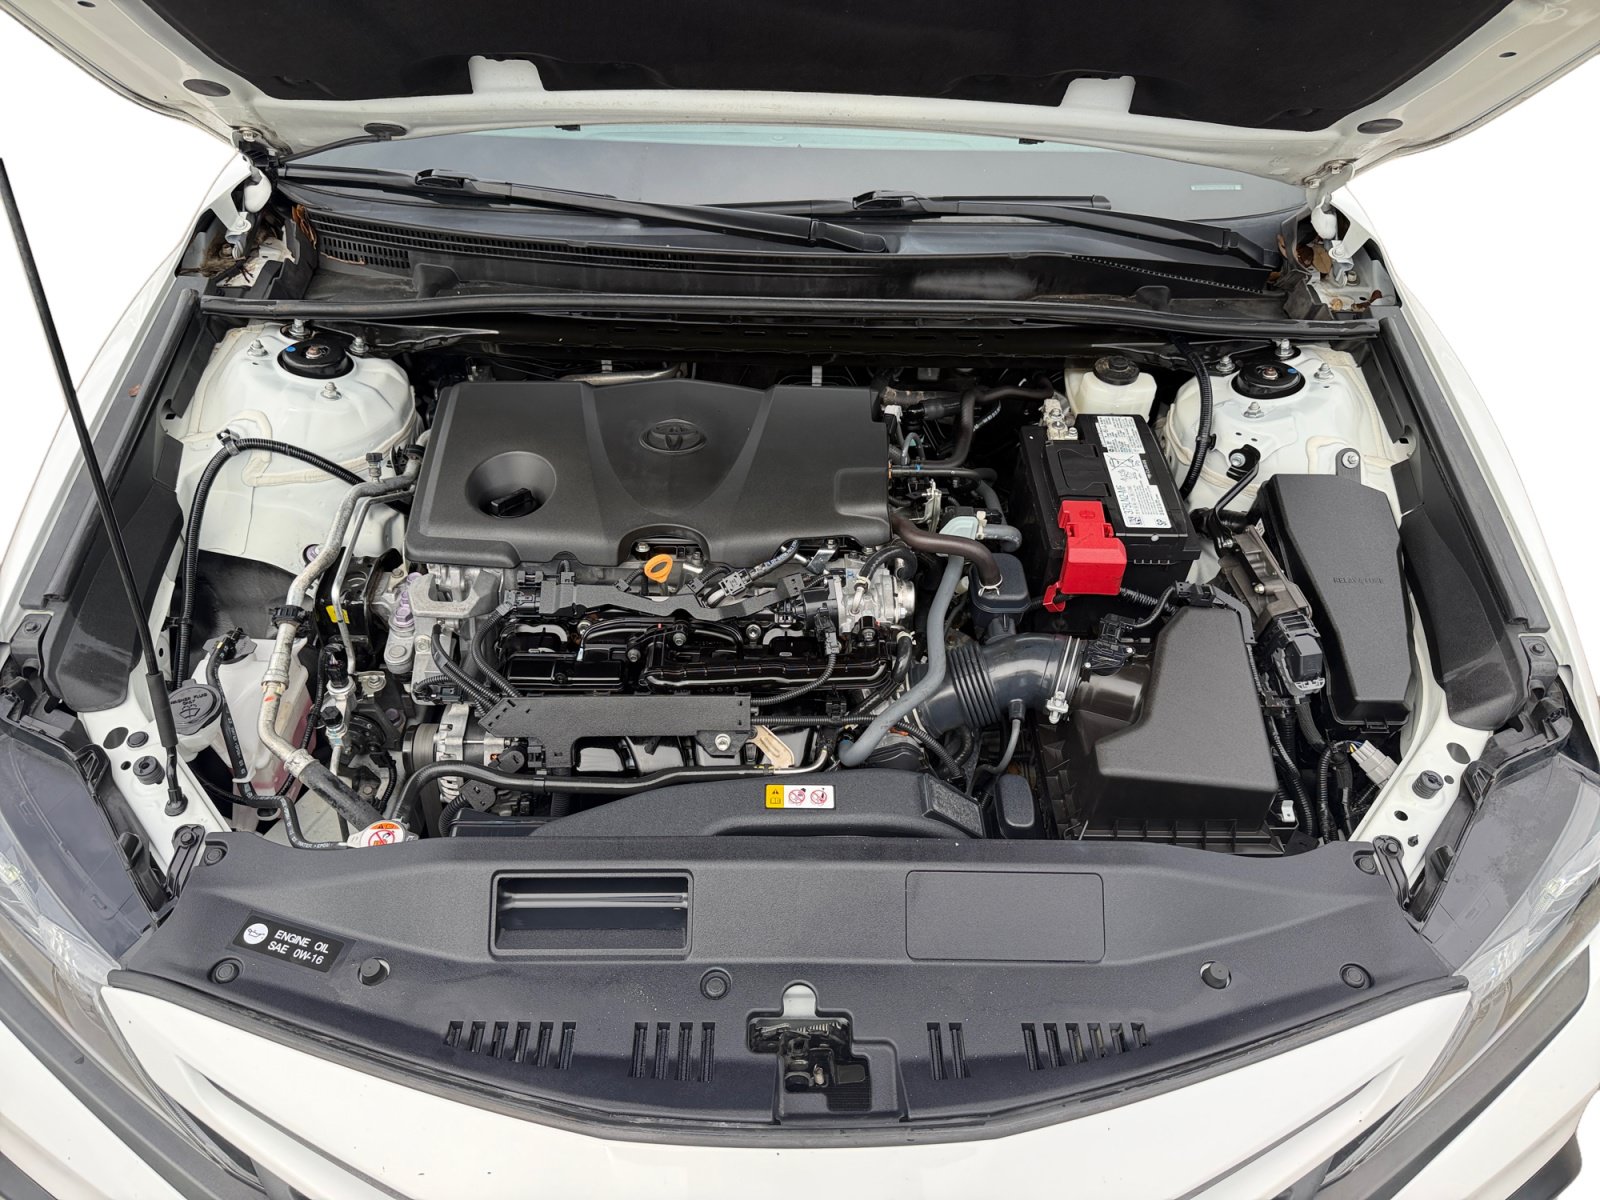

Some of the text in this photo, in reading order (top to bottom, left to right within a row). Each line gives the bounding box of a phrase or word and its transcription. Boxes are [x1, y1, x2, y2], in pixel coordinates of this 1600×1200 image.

[267, 941, 324, 964] SAE 0W-16
[274, 929, 329, 953] ENGINE OIL
